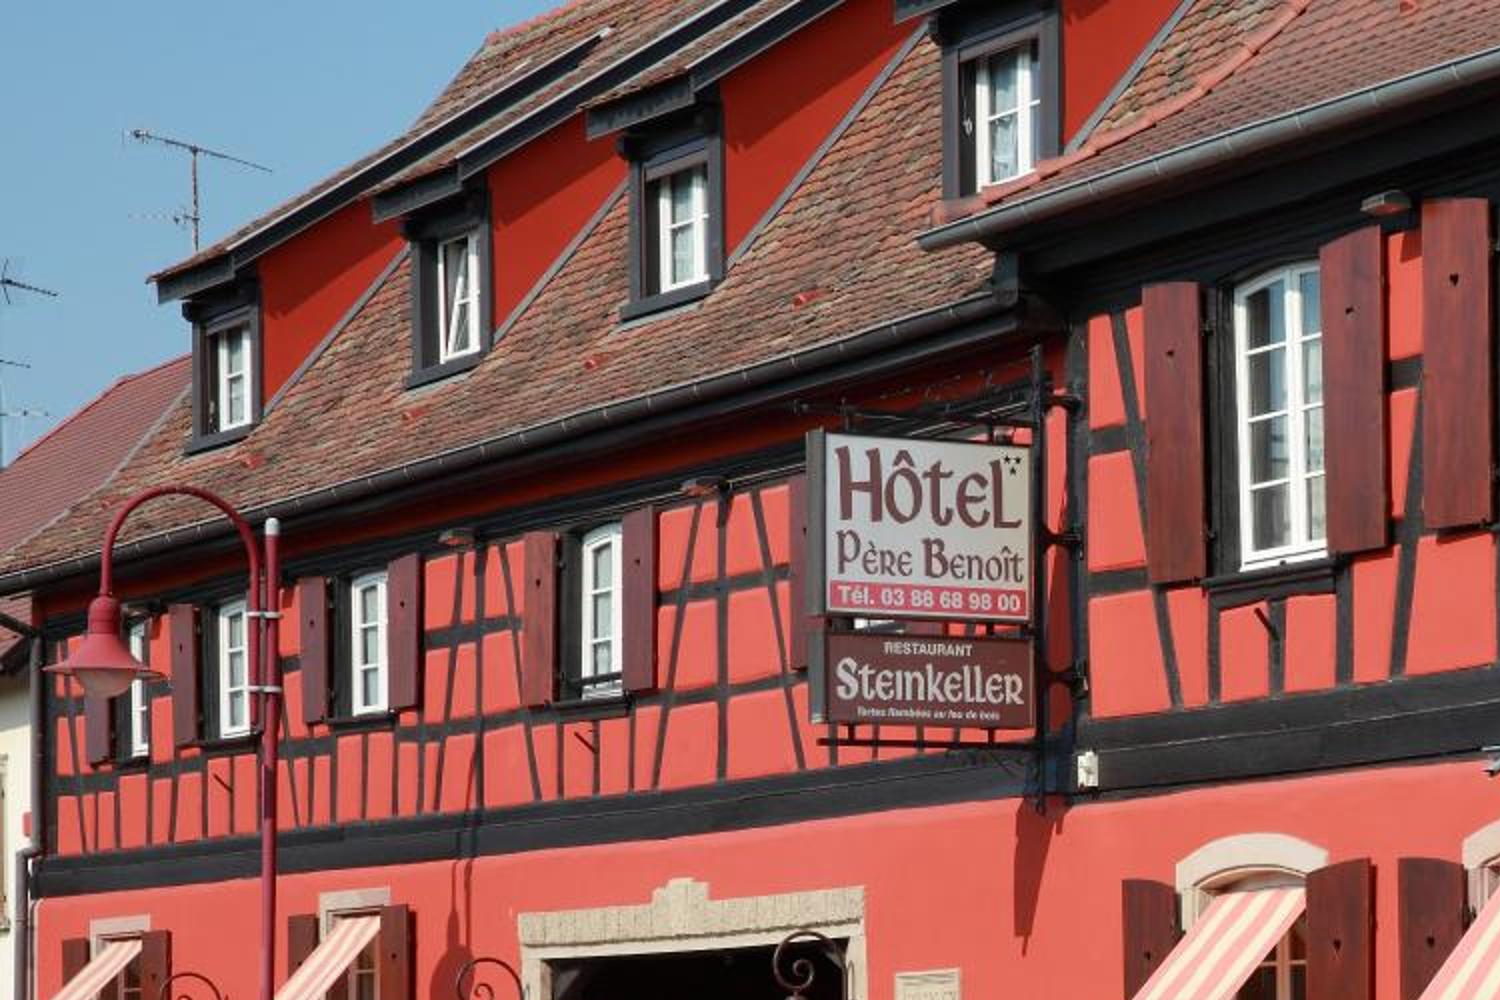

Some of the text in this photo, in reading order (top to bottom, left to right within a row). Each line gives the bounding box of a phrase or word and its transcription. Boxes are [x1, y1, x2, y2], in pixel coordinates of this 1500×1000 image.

[922, 538, 1024, 582] Benoît
[837, 585, 1020, 611] Tél. 03 88 68 98 00
[883, 642, 973, 657] RESTAURANT
[836, 657, 1024, 705] Steinkeller
